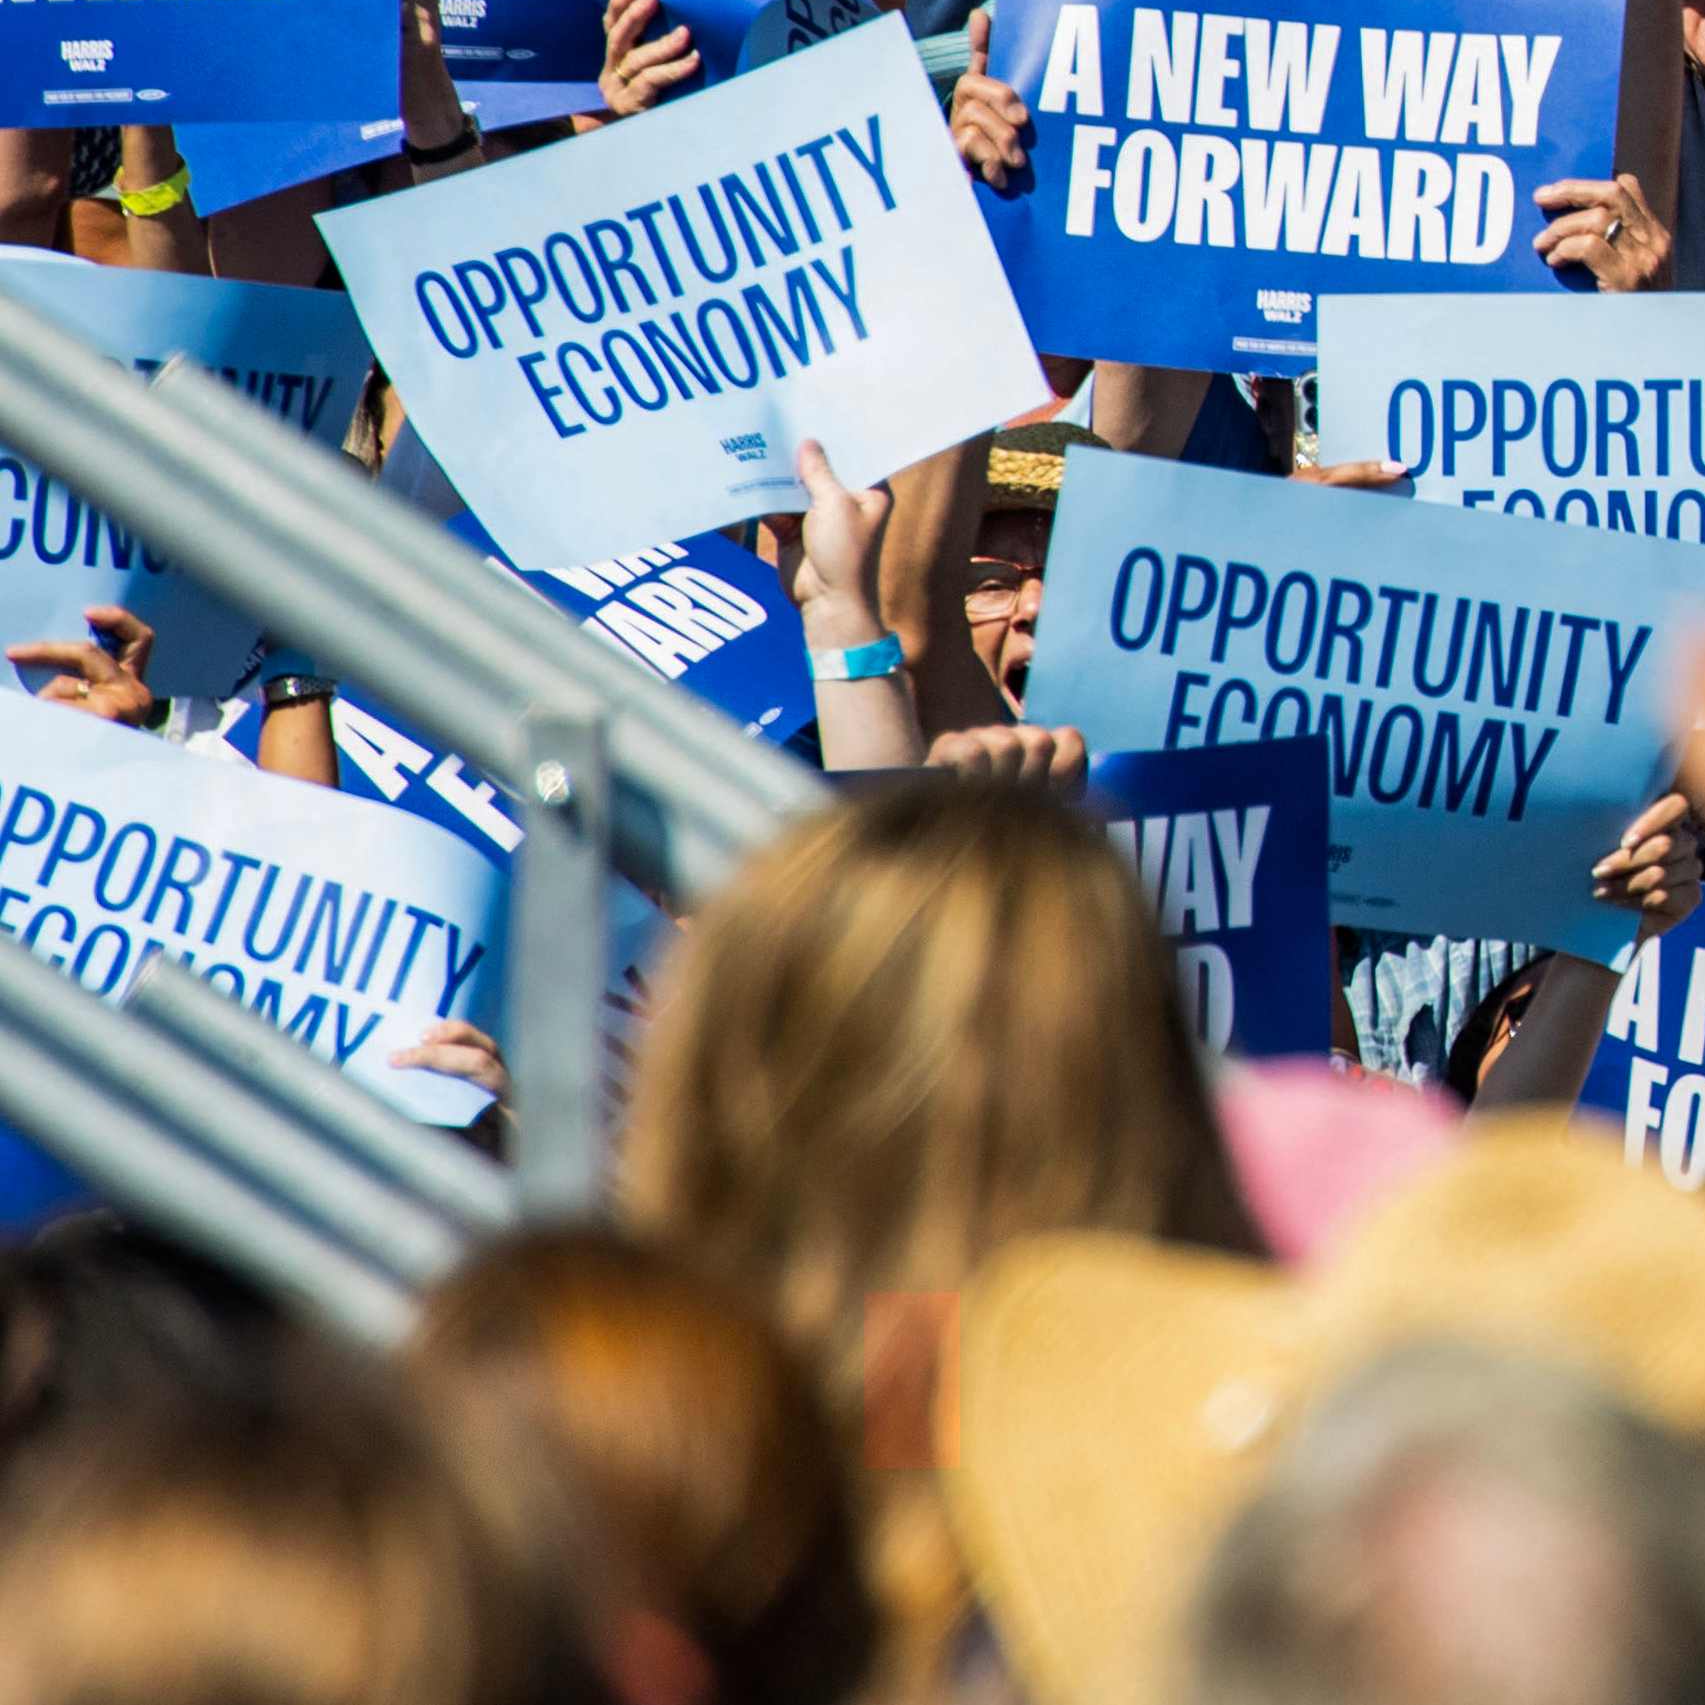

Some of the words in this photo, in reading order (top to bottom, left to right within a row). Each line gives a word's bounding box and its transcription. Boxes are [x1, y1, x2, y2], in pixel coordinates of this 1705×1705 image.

[61, 40, 114, 63] HARRIS
[69, 58, 107, 73] WALZ
[1038, 4, 1104, 116] A
[1126, 7, 1341, 136] NEW
[1360, 27, 1562, 146] WAY
[414, 115, 897, 359] OPPORTUNITY
[1065, 124, 1516, 265] FORWARD
[517, 246, 870, 439] ECONOMY
[1256, 288, 1312, 315] HARRIS
[1264, 308, 1303, 324] WALZ
[720, 431, 767, 458] HARRIS
[735, 447, 767, 463] WALZ
[1111, 545, 1654, 726] OPPORTUNITY
[0, 783, 485, 1018] PPORTUNITY
[1607, 944, 1661, 1043] A
